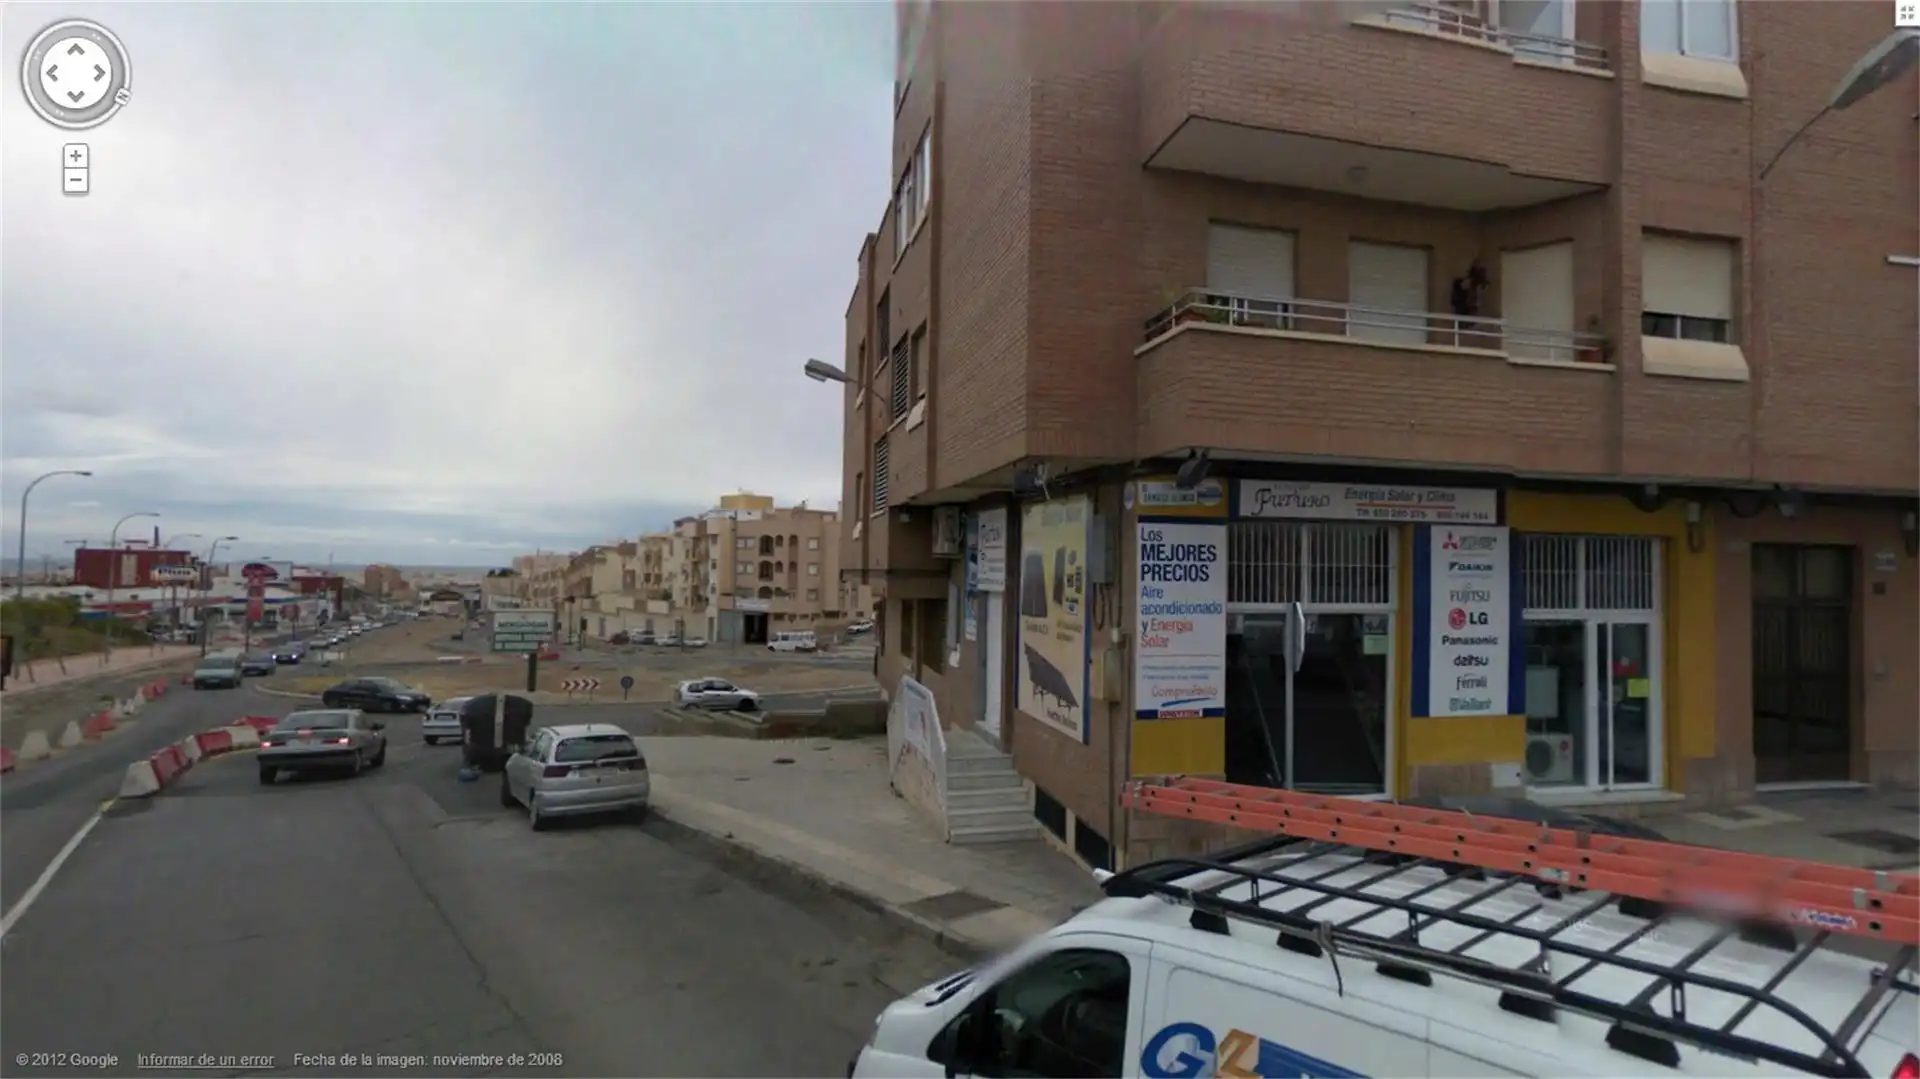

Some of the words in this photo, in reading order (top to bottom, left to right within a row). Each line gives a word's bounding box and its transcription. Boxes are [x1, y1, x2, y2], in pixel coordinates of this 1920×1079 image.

[1388, 488, 1414, 502] Solar
[1140, 527, 1163, 542] Los
[1140, 544, 1217, 562] MEJORES
[1140, 563, 1210, 582] PRECIOS
[1140, 586, 1164, 599] Aire
[1450, 590, 1490, 604] FUJITSU
[1140, 600, 1223, 616] acondicionado
[1469, 611, 1488, 625] LG
[1141, 620, 1149, 635] y
[1140, 633, 1169, 648] Solar
[1441, 635, 1499, 646] Panasonic
